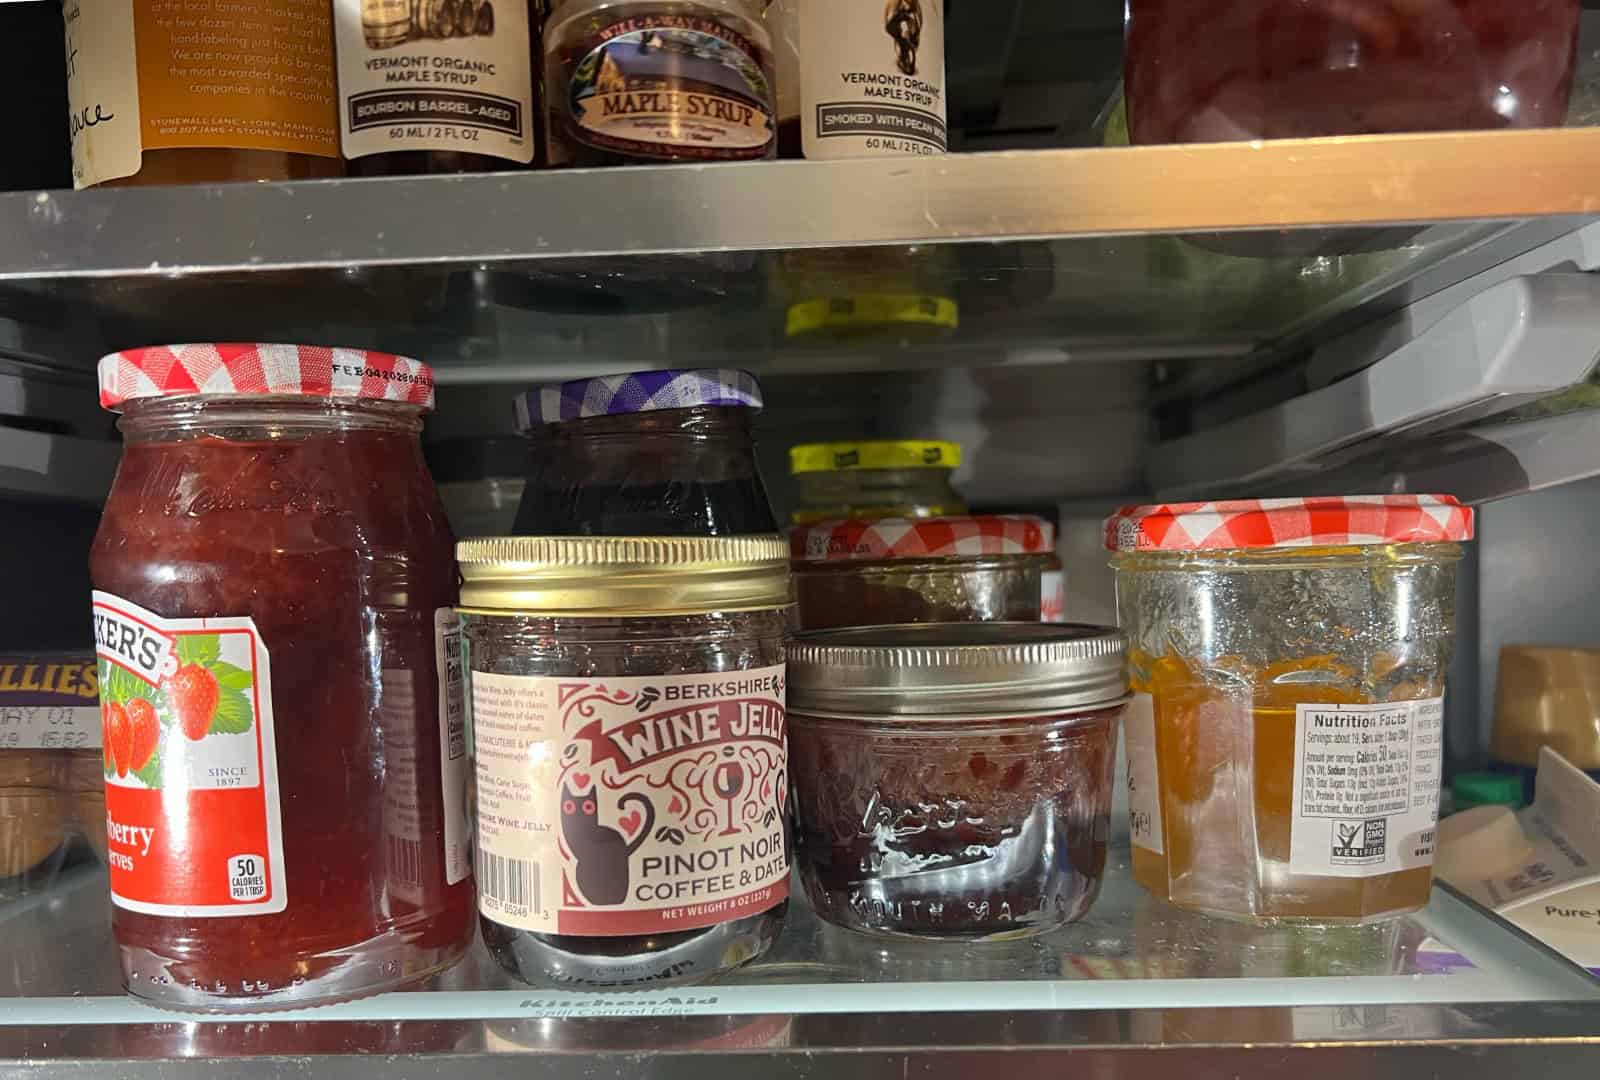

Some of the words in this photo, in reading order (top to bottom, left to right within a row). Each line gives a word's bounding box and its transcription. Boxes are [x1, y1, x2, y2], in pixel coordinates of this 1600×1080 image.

[172, 49, 193, 61] We
[195, 52, 214, 61] are
[215, 51, 242, 63] now
[244, 51, 280, 66] proud
[169, 65, 186, 76] the
[189, 66, 215, 77] most
[218, 68, 271, 81] awarded
[364, 56, 428, 71] VERMONT
[431, 56, 496, 76] ORGANIC
[385, 71, 430, 83] MAPLE
[433, 72, 478, 85] SYRUP
[841, 72, 901, 86] VERMONT
[189, 82, 250, 96] companies
[254, 85, 266, 97] in
[269, 85, 287, 97] the
[864, 86, 902, 101] MAPLE
[904, 90, 932, 106] SYRUP
[357, 100, 415, 118] BOURBON
[418, 100, 512, 121] BARREL-AGED
[602, 92, 677, 117] MAPLE
[686, 93, 754, 128] SYRUP
[824, 113, 873, 126] SMOKED
[875, 114, 903, 128] WITH
[389, 128, 405, 139] 60
[445, 128, 460, 139] FL
[462, 129, 480, 142] OZ
[865, 139, 880, 150] 60
[664, 677, 771, 702] BERKSHIRE
[1314, 713, 1376, 729] Nutrition
[1379, 712, 1407, 727] Facts
[608, 704, 722, 764] WINE
[729, 701, 784, 748] JELLY
[1334, 731, 1350, 744] about
[1356, 750, 1377, 763] Calories
[1379, 745, 1387, 761] 50
[208, 767, 249, 777] SINCE
[1327, 766, 1346, 776] Sodium
[216, 777, 241, 787] 1897
[1316, 791, 1335, 801] Protein
[497, 815, 521, 830] WINE
[521, 818, 552, 832] JELLY
[1365, 820, 1385, 831] NON
[1366, 829, 1385, 840] GMO
[641, 847, 734, 878] PINOT
[739, 832, 782, 865] NOIR
[1335, 847, 1384, 857] VERIFIED
[237, 859, 255, 877] 50
[231, 877, 264, 888] CALORIES
[635, 873, 735, 902] COFFEE
[739, 870, 752, 887] &
[754, 855, 785, 882] DATE
[232, 887, 245, 898] PER
[249, 886, 264, 897] TBSP
[661, 906, 684, 921] NET
[687, 901, 728, 918] WEIGHT
[738, 896, 750, 907] OZ
[518, 996, 719, 1009] KitchenAid
[577, 1006, 648, 1017] Control
[650, 1006, 697, 1016] Edge
